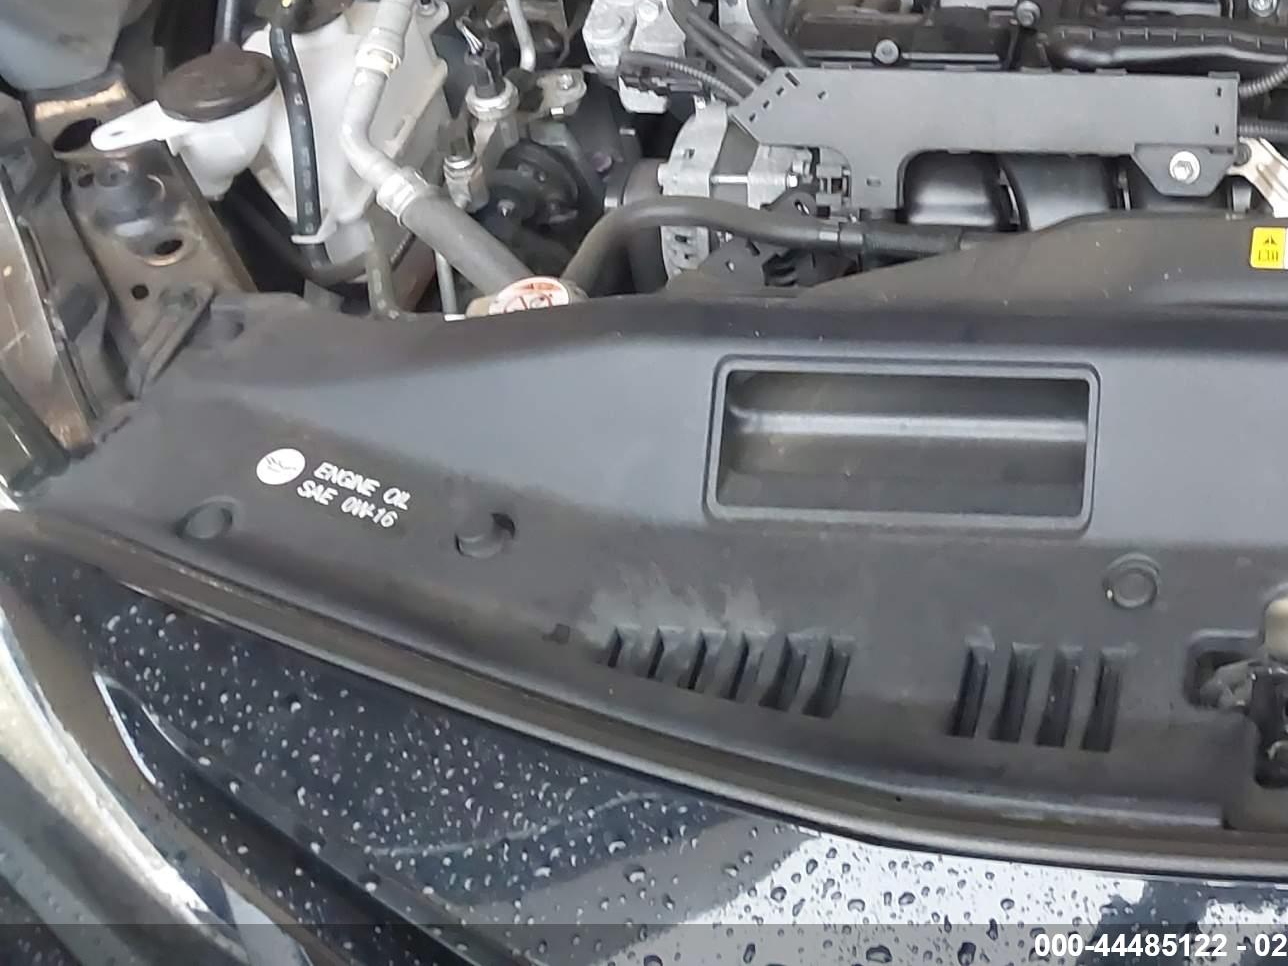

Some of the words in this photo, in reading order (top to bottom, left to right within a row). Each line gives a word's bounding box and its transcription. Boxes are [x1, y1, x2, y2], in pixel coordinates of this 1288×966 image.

[296, 480, 339, 506] SAE
[313, 462, 381, 497] ENGINE
[382, 487, 412, 511] OIL
